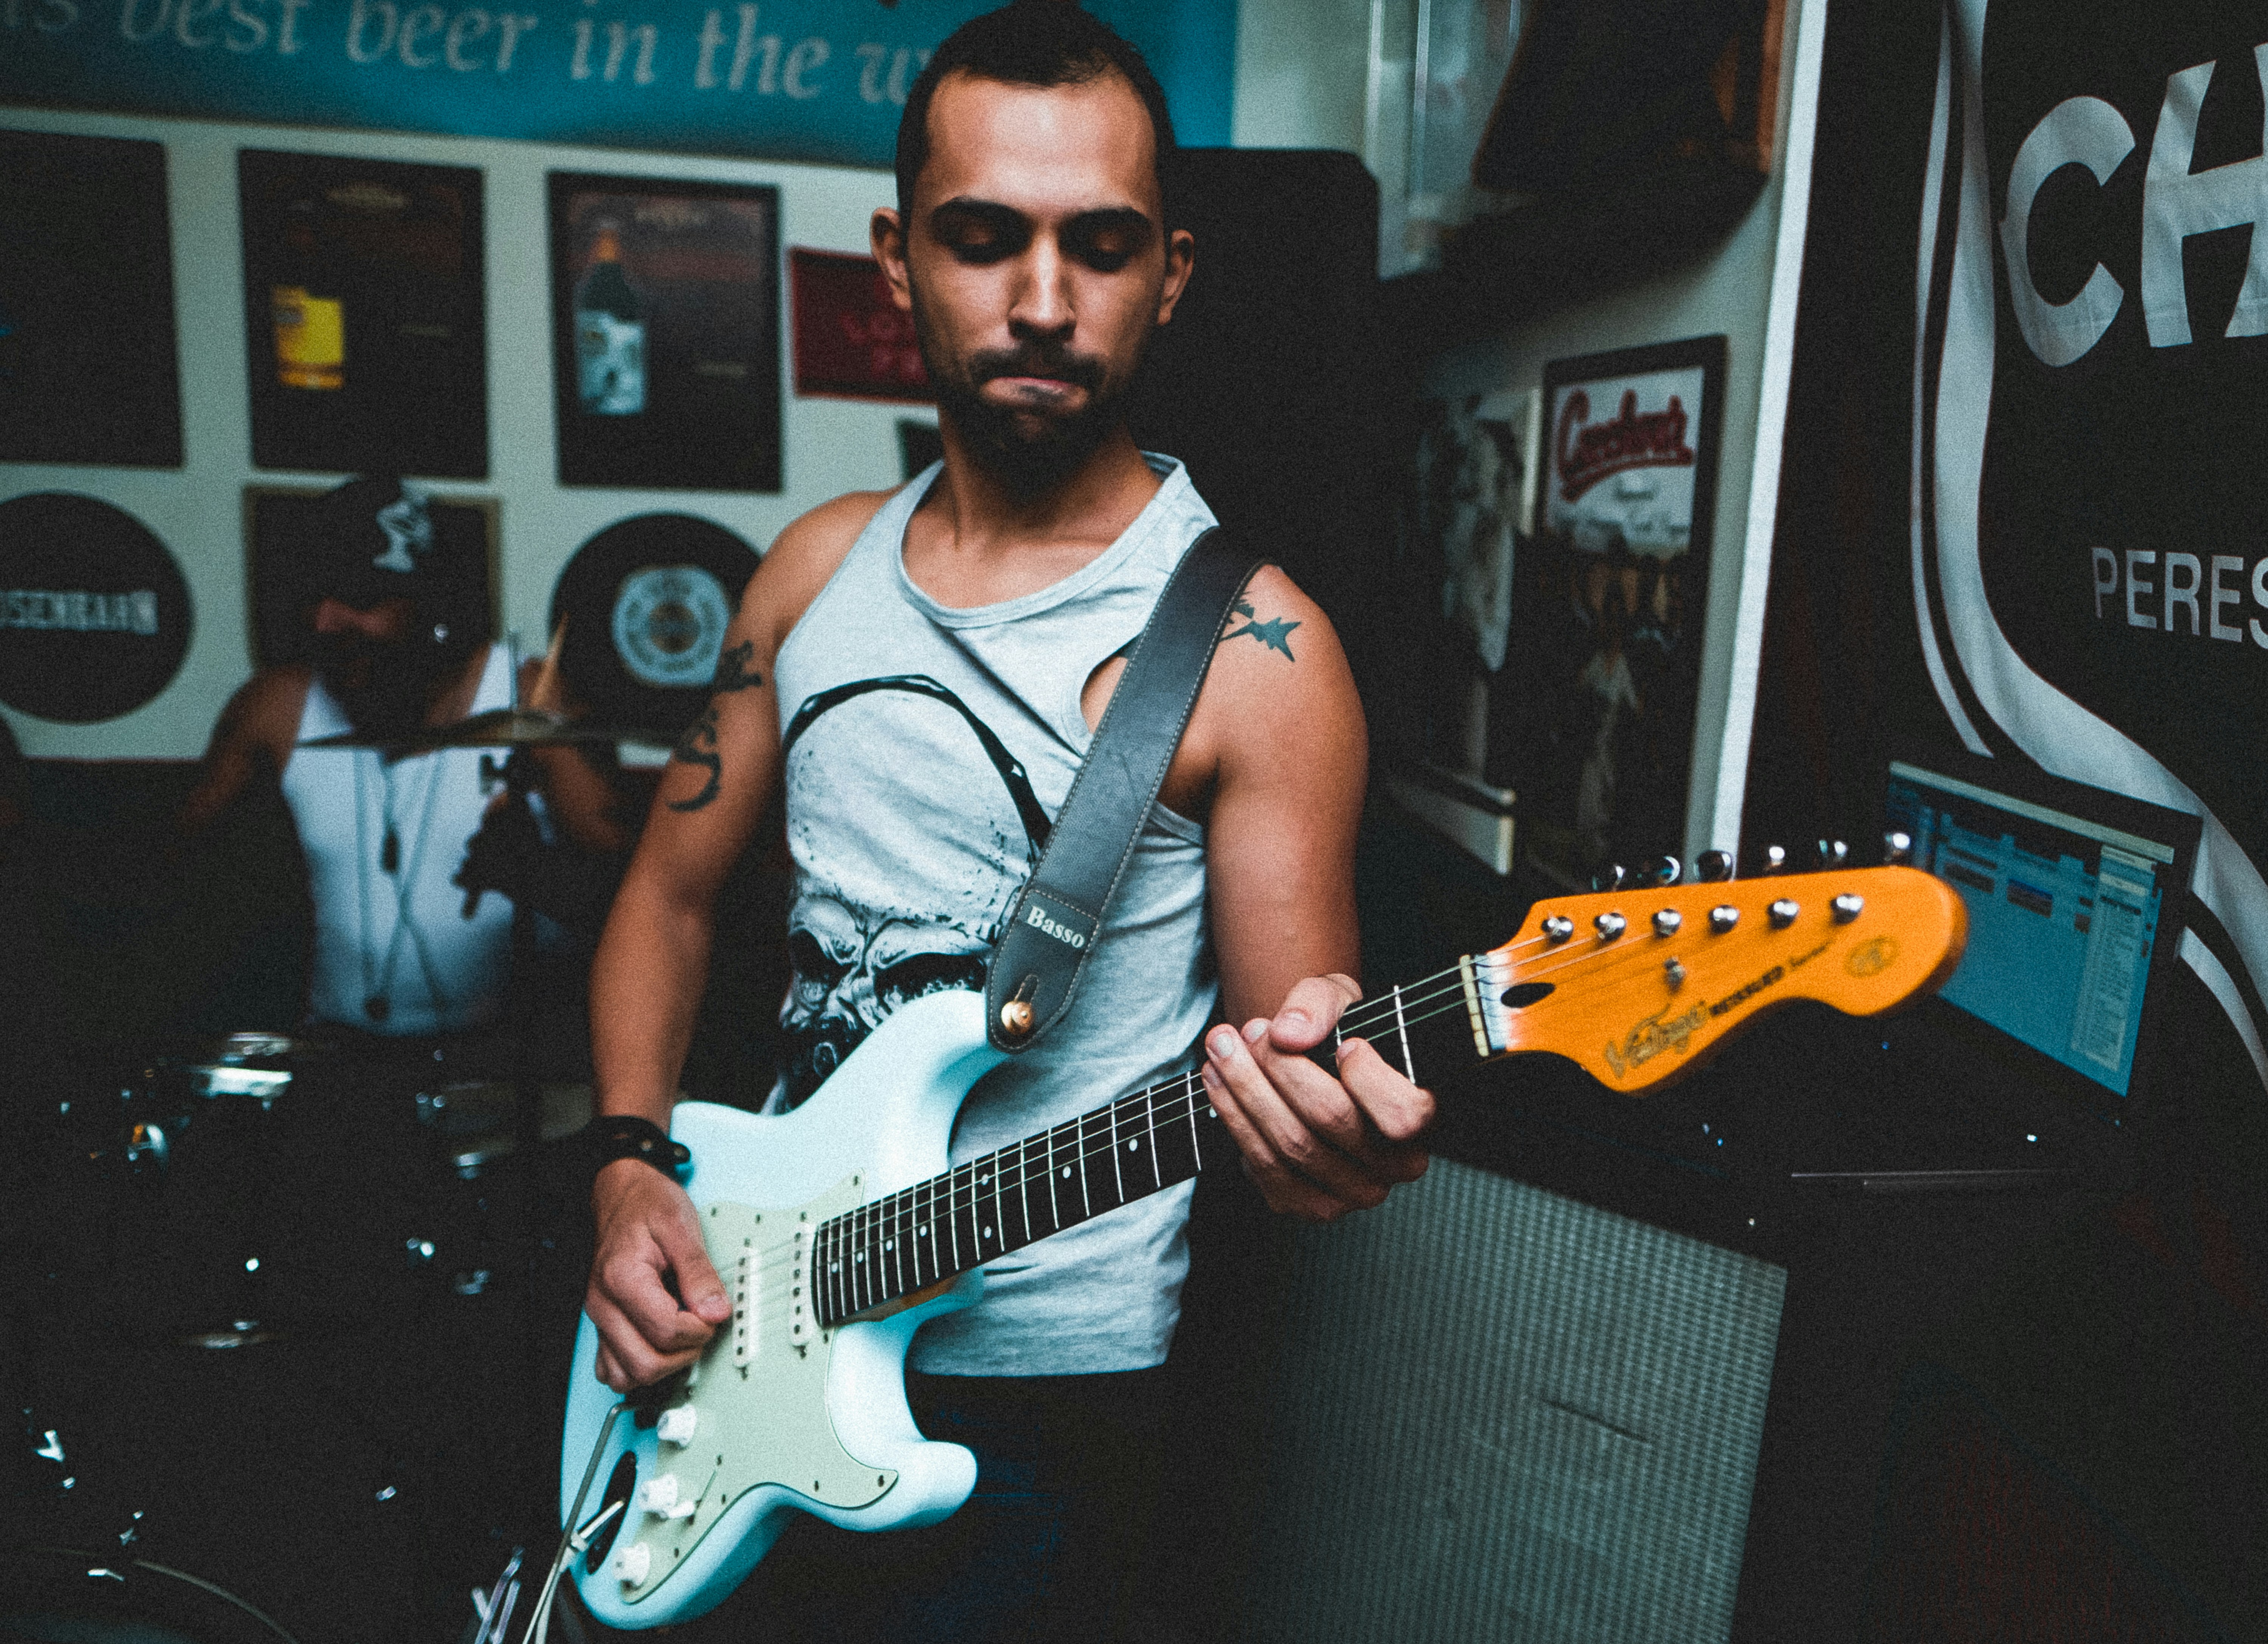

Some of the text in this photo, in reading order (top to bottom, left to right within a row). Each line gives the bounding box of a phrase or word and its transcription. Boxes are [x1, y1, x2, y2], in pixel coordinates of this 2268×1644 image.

[345, 0, 538, 72] beer
[693, 2, 831, 100] the
[1026, 905, 1085, 948] Basso
